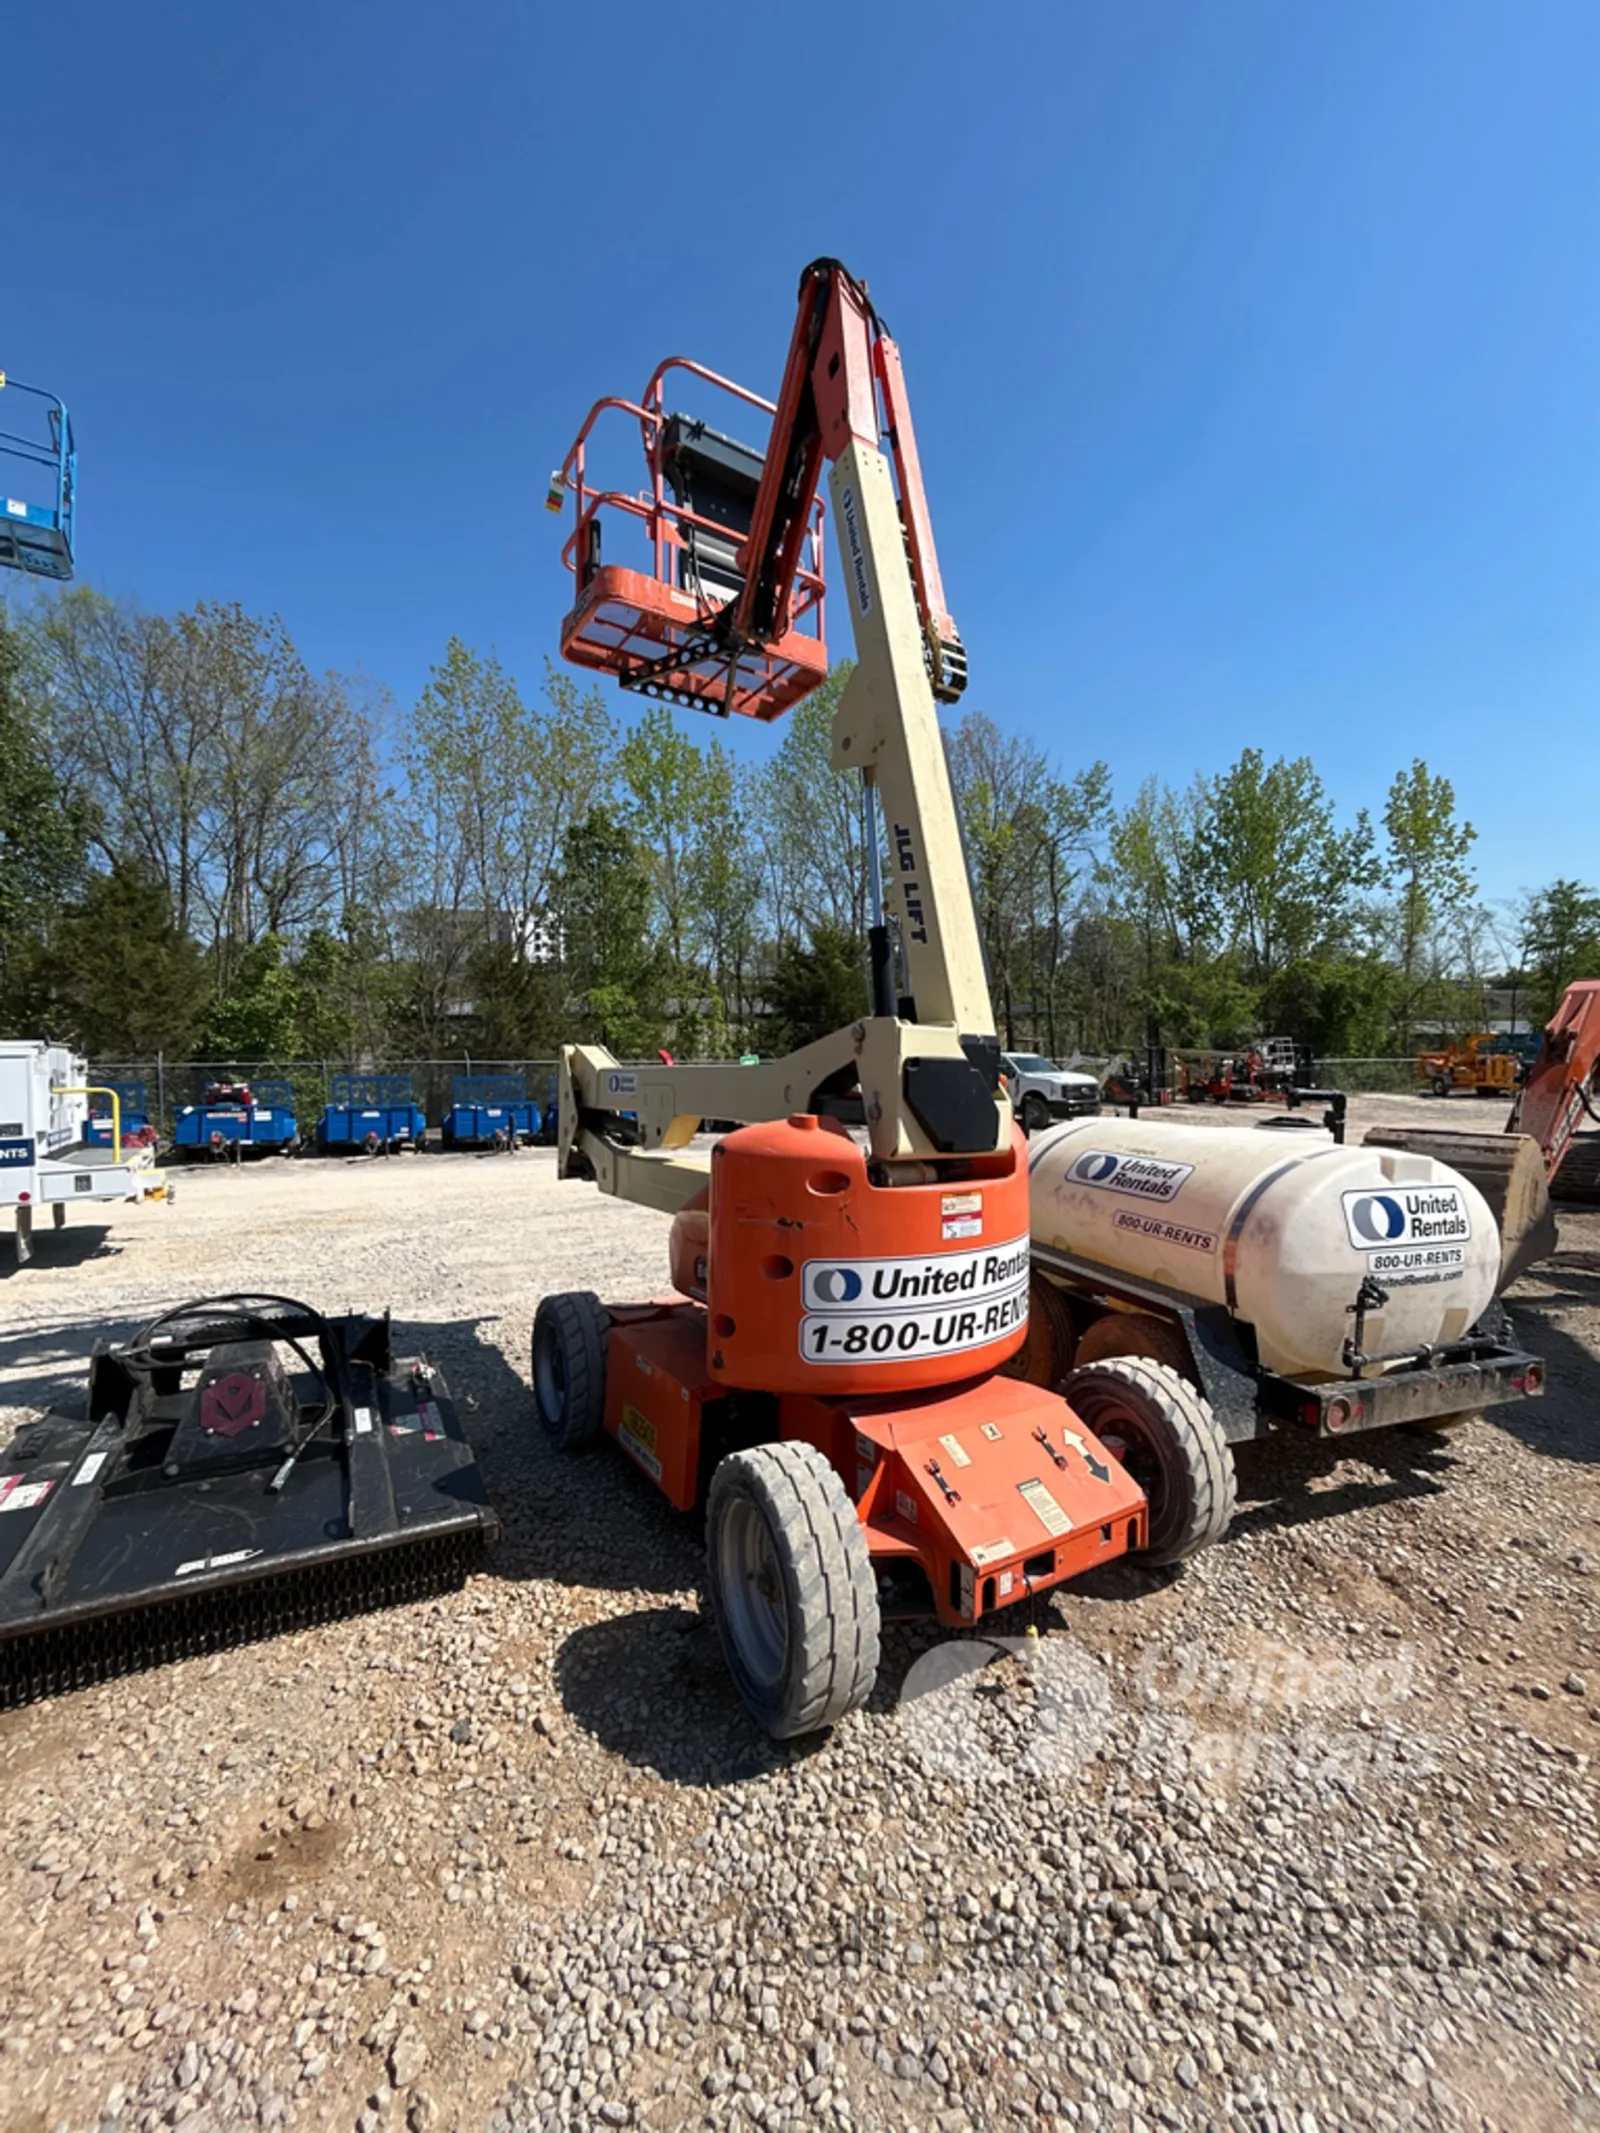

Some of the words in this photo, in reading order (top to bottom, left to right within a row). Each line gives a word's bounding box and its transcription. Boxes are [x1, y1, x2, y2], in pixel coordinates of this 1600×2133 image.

[846, 508, 861, 557] United
[854, 556, 870, 610] Rentals
[894, 823, 915, 871] JLG
[903, 883, 928, 944] LIFT
[1110, 1172, 1174, 1196] Rentals
[1120, 1159, 1182, 1180] United
[1406, 1193, 1458, 1215] United
[1117, 1214, 1212, 1249] 800-UR-RENTS
[1410, 1215, 1467, 1238] Rentals
[872, 1260, 978, 1299] United
[983, 1244, 1030, 1285] Rental
[1374, 1249, 1462, 1270] 800-UR-RENTS
